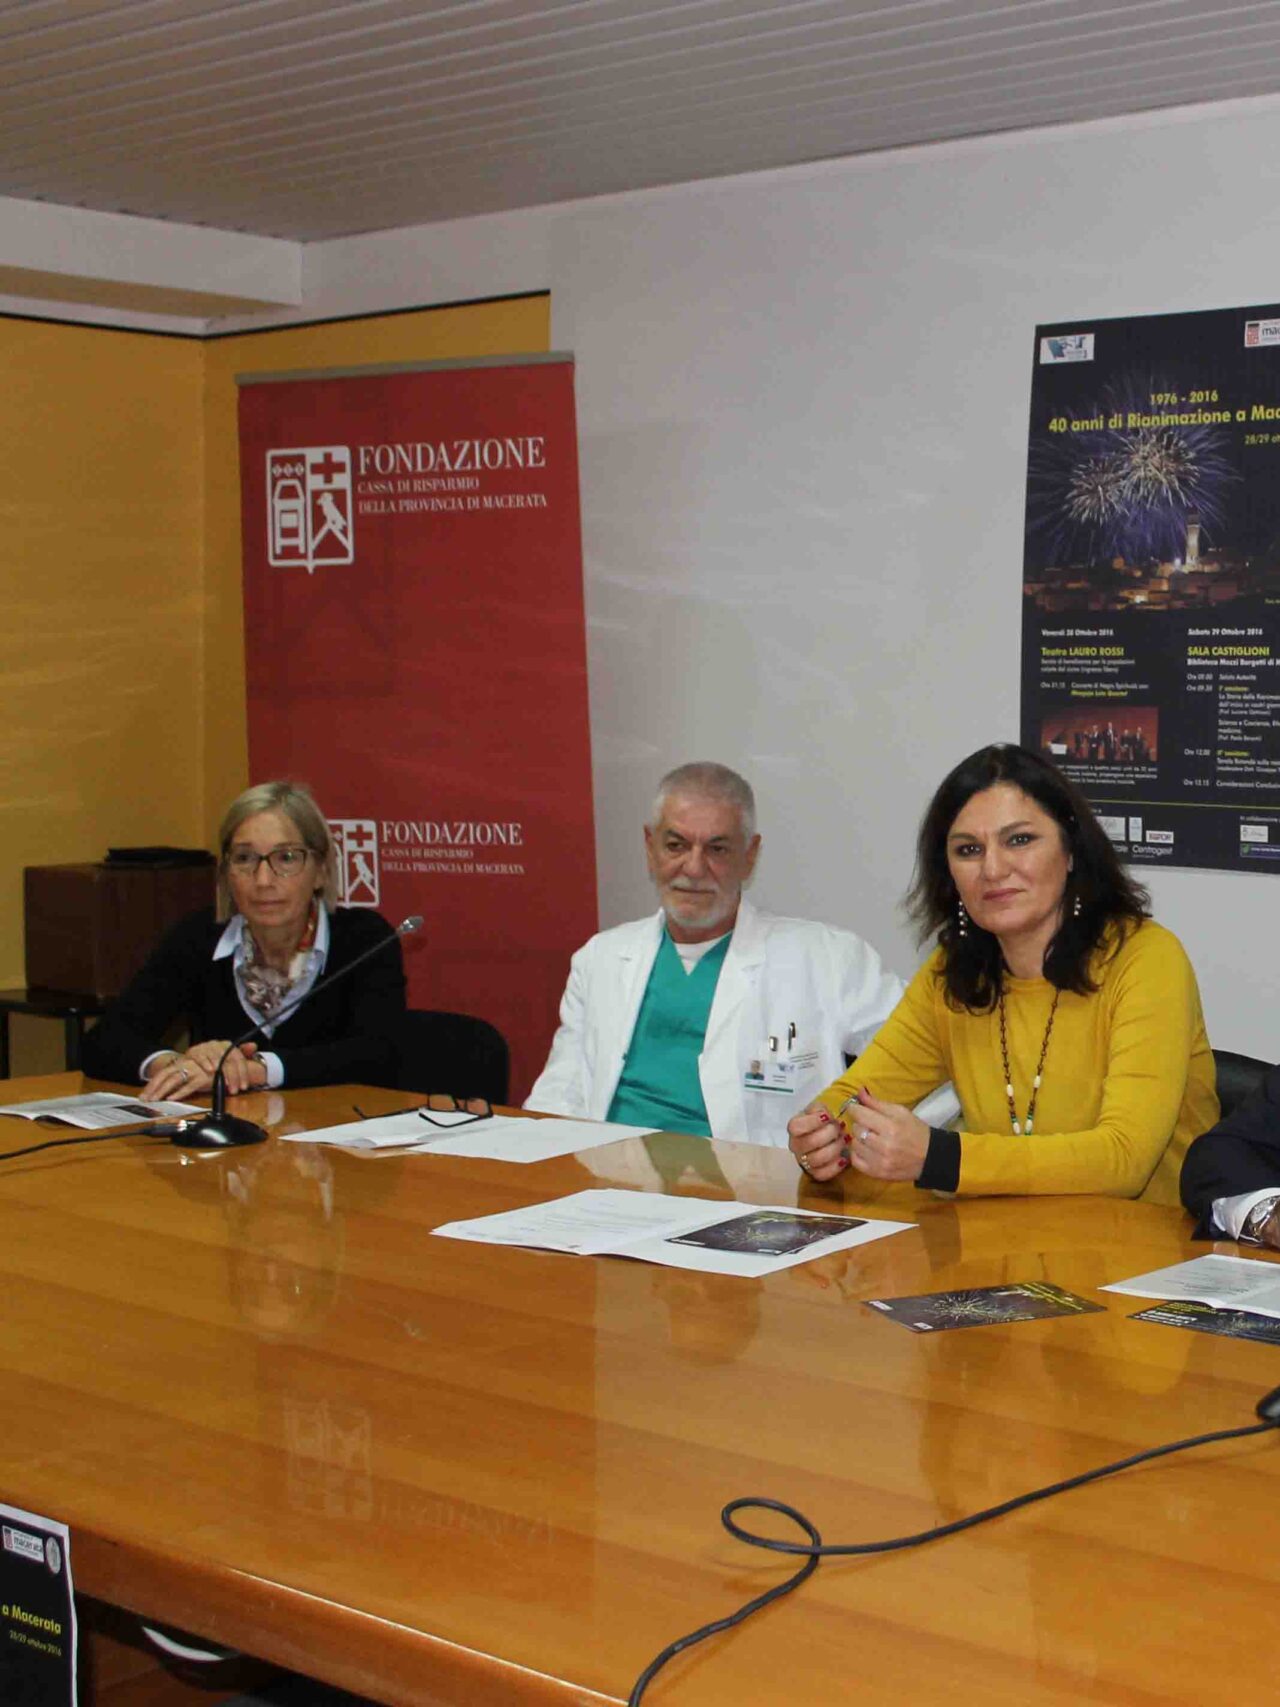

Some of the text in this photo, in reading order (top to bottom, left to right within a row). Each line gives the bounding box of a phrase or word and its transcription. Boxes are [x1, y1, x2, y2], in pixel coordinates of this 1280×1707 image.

[1151, 392, 1178, 405] 1976
[1190, 390, 1219, 403] 2016
[1049, 418, 1067, 433] 40
[1071, 415, 1104, 431] anni
[1108, 413, 1123, 429] di
[1127, 409, 1231, 428] Rianimazione
[1236, 411, 1246, 422] a
[358, 437, 546, 476] FONDAZIONE
[357, 477, 480, 494] CASSA DI RISPARMIO
[359, 494, 547, 514] DELLA PROVINCIA DI MACERATA
[1041, 647, 1124, 656] Teatro LAURO ROSSI
[1187, 647, 1270, 656] SALA CASTIGLIONI
[381, 821, 523, 845] FONDAZIONE
[411, 849, 421, 858] DI
[475, 863, 525, 875] MACERATA
[2, 1604, 61, 1634] a Macerata
